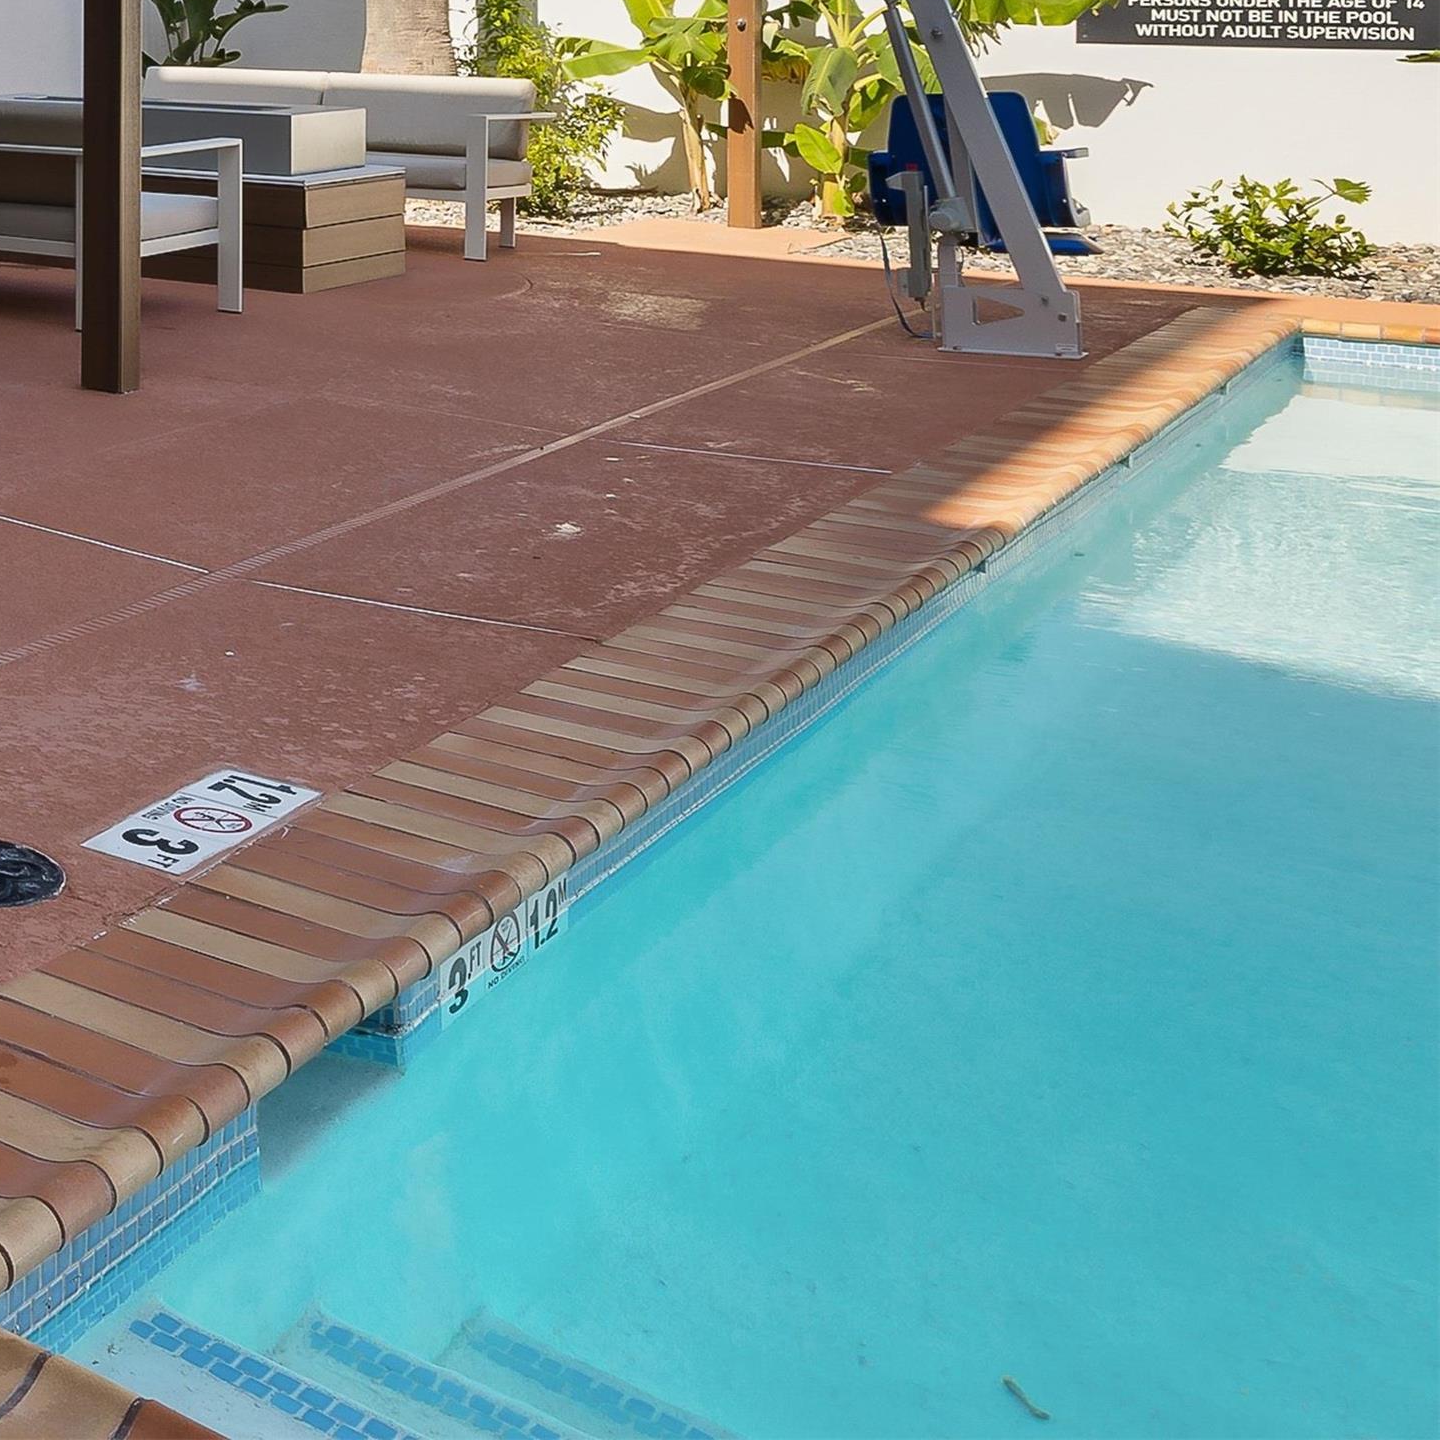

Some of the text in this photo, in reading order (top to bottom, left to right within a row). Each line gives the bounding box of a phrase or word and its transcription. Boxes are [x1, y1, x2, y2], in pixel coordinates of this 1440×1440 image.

[1151, 9, 1398, 24] MUST NOT BE IN THE POOL
[1135, 24, 1414, 40] WITHOUT ADULT SUPERVISION
[530, 878, 567, 949] 1.2 M
